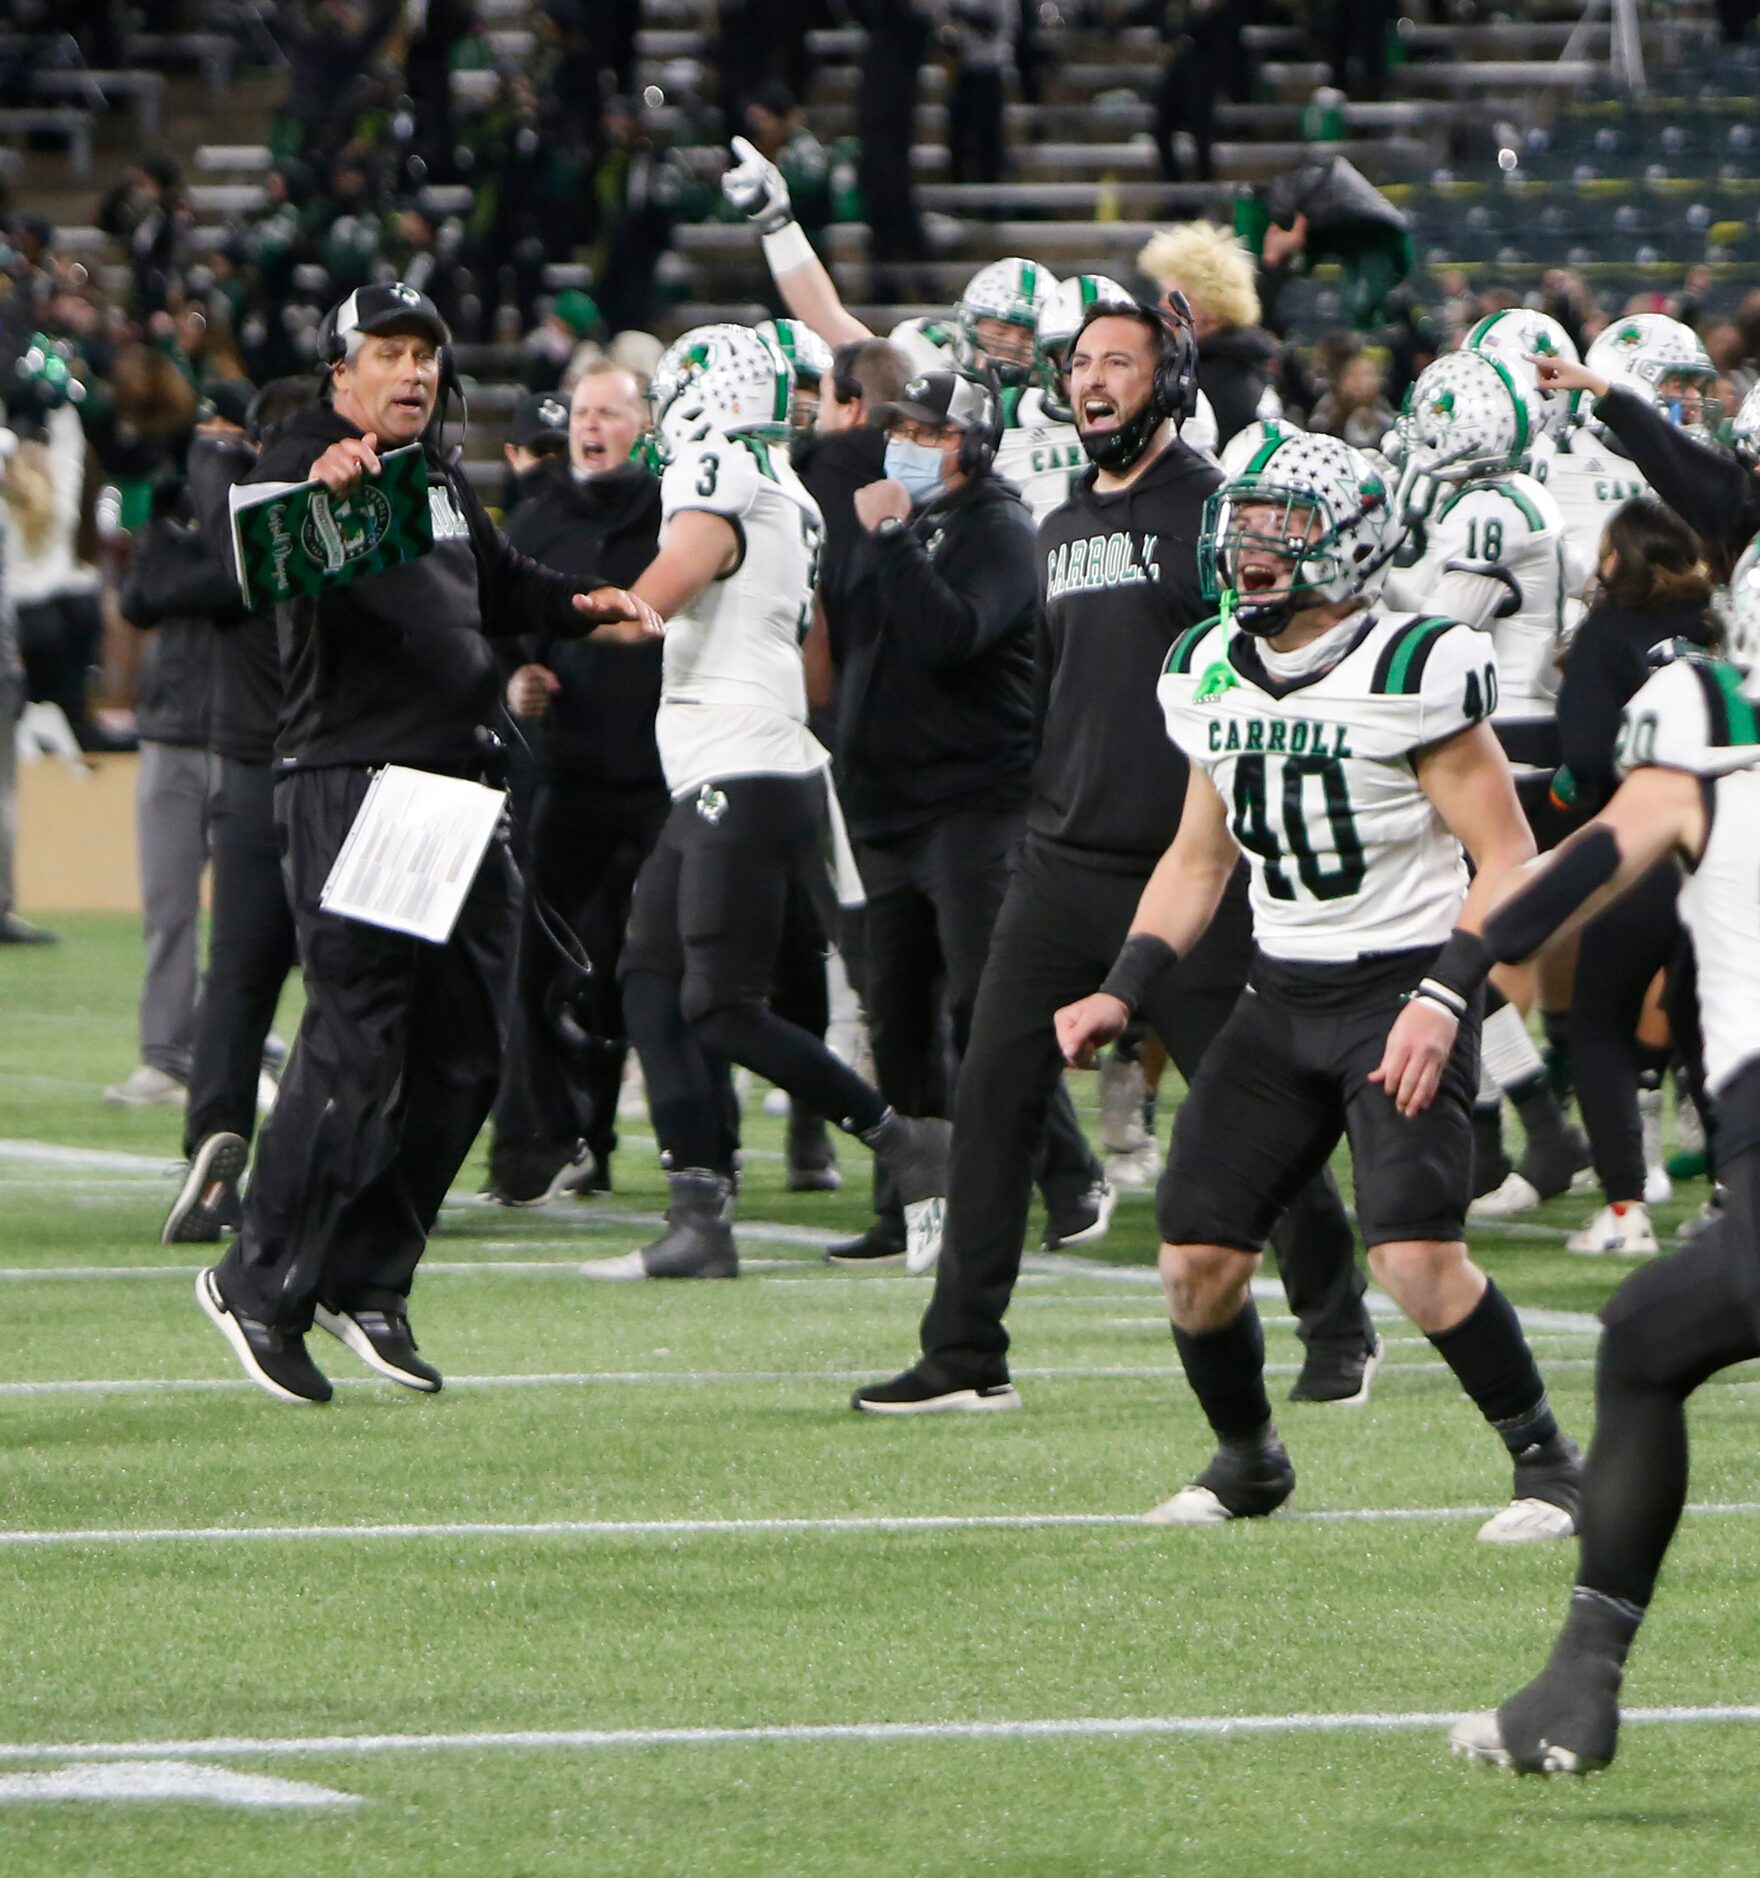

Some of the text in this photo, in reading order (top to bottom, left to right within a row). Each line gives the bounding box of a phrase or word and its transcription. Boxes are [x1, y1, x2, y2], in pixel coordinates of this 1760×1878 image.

[696, 453, 720, 496] 3
[1466, 517, 1503, 561] 18
[1046, 531, 1161, 602] CARROLL
[1463, 662, 1499, 719] 40
[1208, 719, 1352, 758] CARROLL
[1233, 754, 1366, 902] 40
